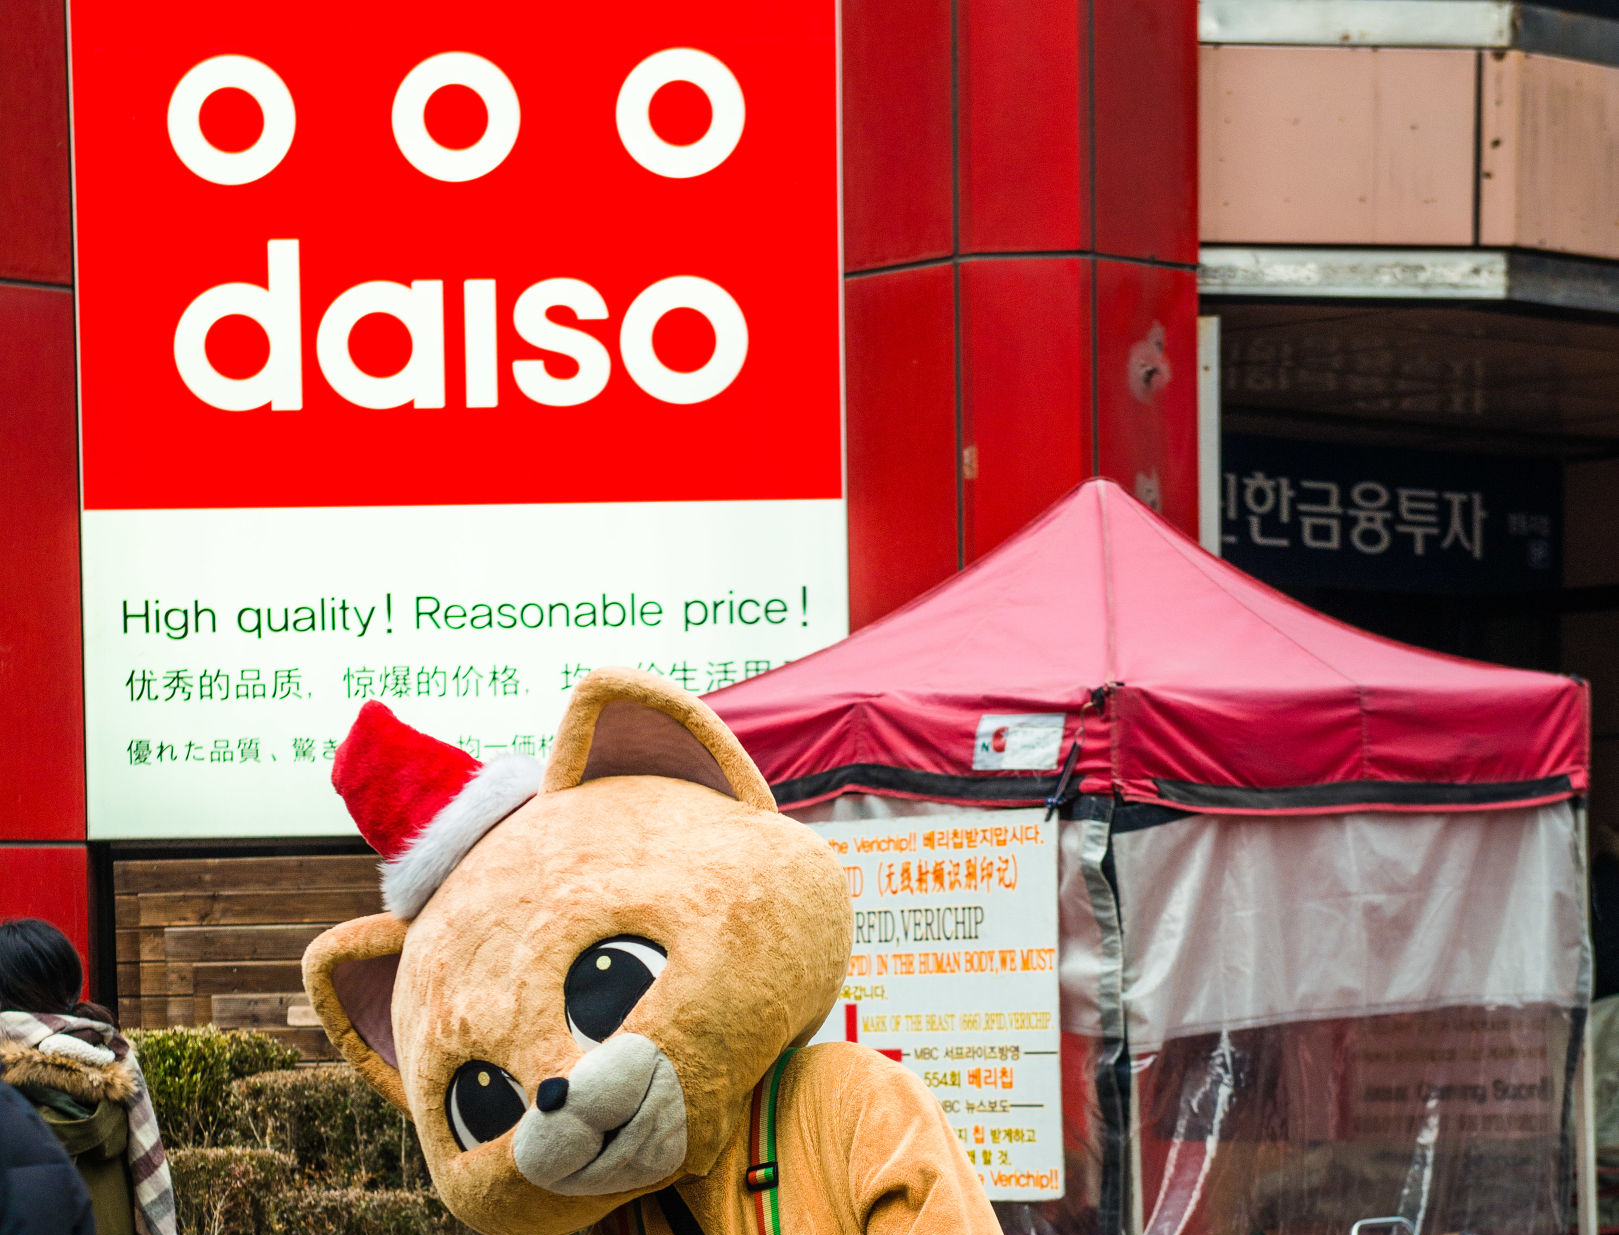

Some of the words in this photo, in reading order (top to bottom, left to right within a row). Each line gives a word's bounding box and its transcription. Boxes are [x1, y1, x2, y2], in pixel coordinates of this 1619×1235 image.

[173, 238, 750, 412] daiso
[122, 599, 217, 641] High
[415, 592, 664, 630] Reasonable
[684, 585, 809, 632] price!
[876, 953, 889, 976] IN
[891, 952, 916, 975] THE
[918, 951, 961, 975] HUMAN
[1019, 947, 1056, 972] MUST
[914, 1046, 939, 1060] MBC
[967, 1066, 1014, 1090] 베리칩
[990, 1169, 1059, 1191] Verichip!!
